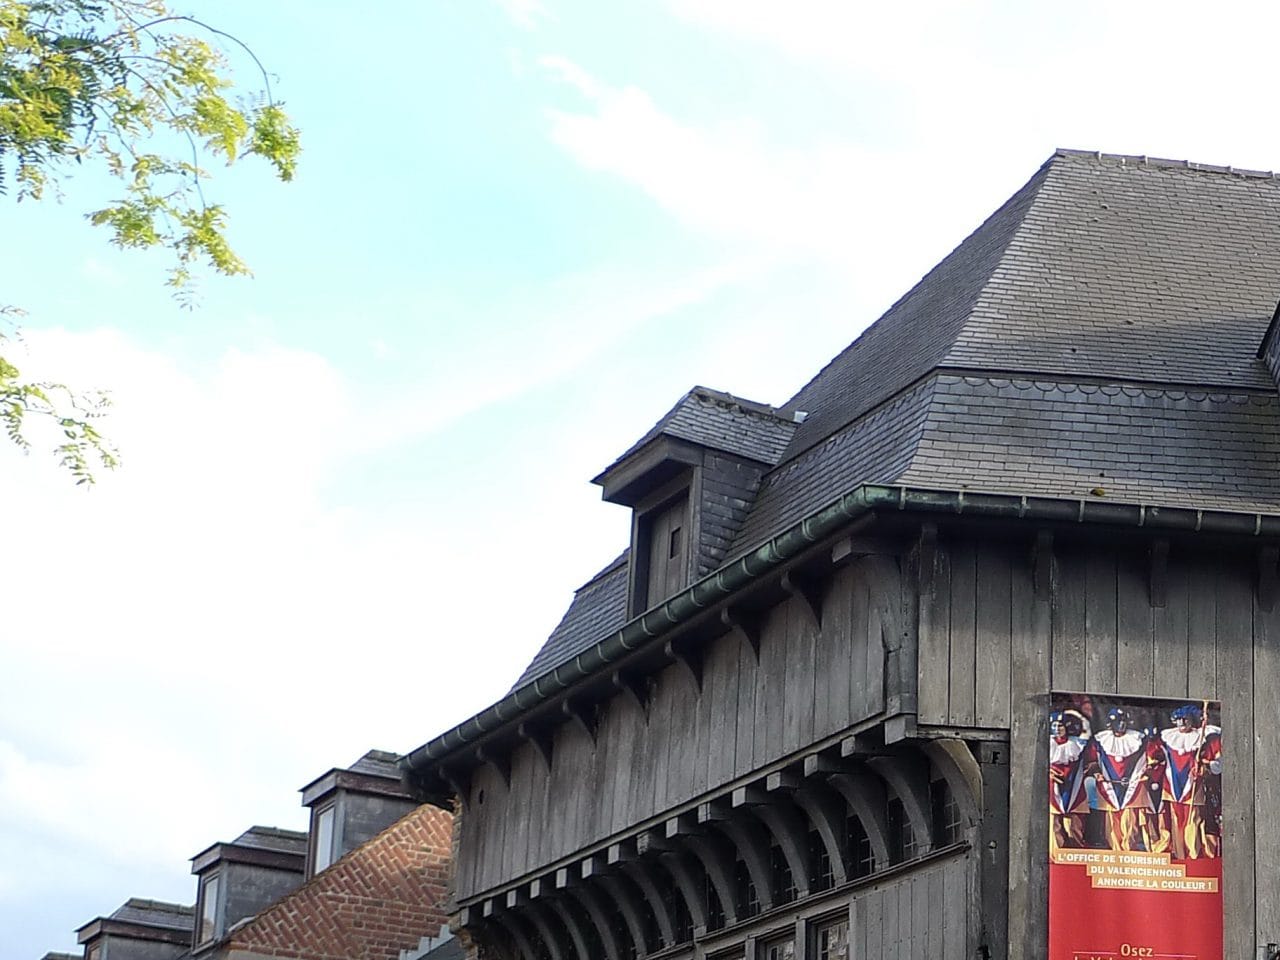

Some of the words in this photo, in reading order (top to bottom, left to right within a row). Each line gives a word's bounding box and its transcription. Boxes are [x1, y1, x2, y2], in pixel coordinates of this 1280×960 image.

[1058, 853, 1100, 862] L'OFFICE
[1103, 854, 1116, 863] DE
[1119, 855, 1168, 865] TOURISME
[1091, 865, 1104, 874] DU
[1107, 866, 1183, 877] VALENCIENNOIS
[1097, 878, 1144, 888] ANNONCE
[1146, 879, 1158, 888] LA
[1161, 880, 1206, 890] COULEUR
[1120, 943, 1153, 957] Osez
